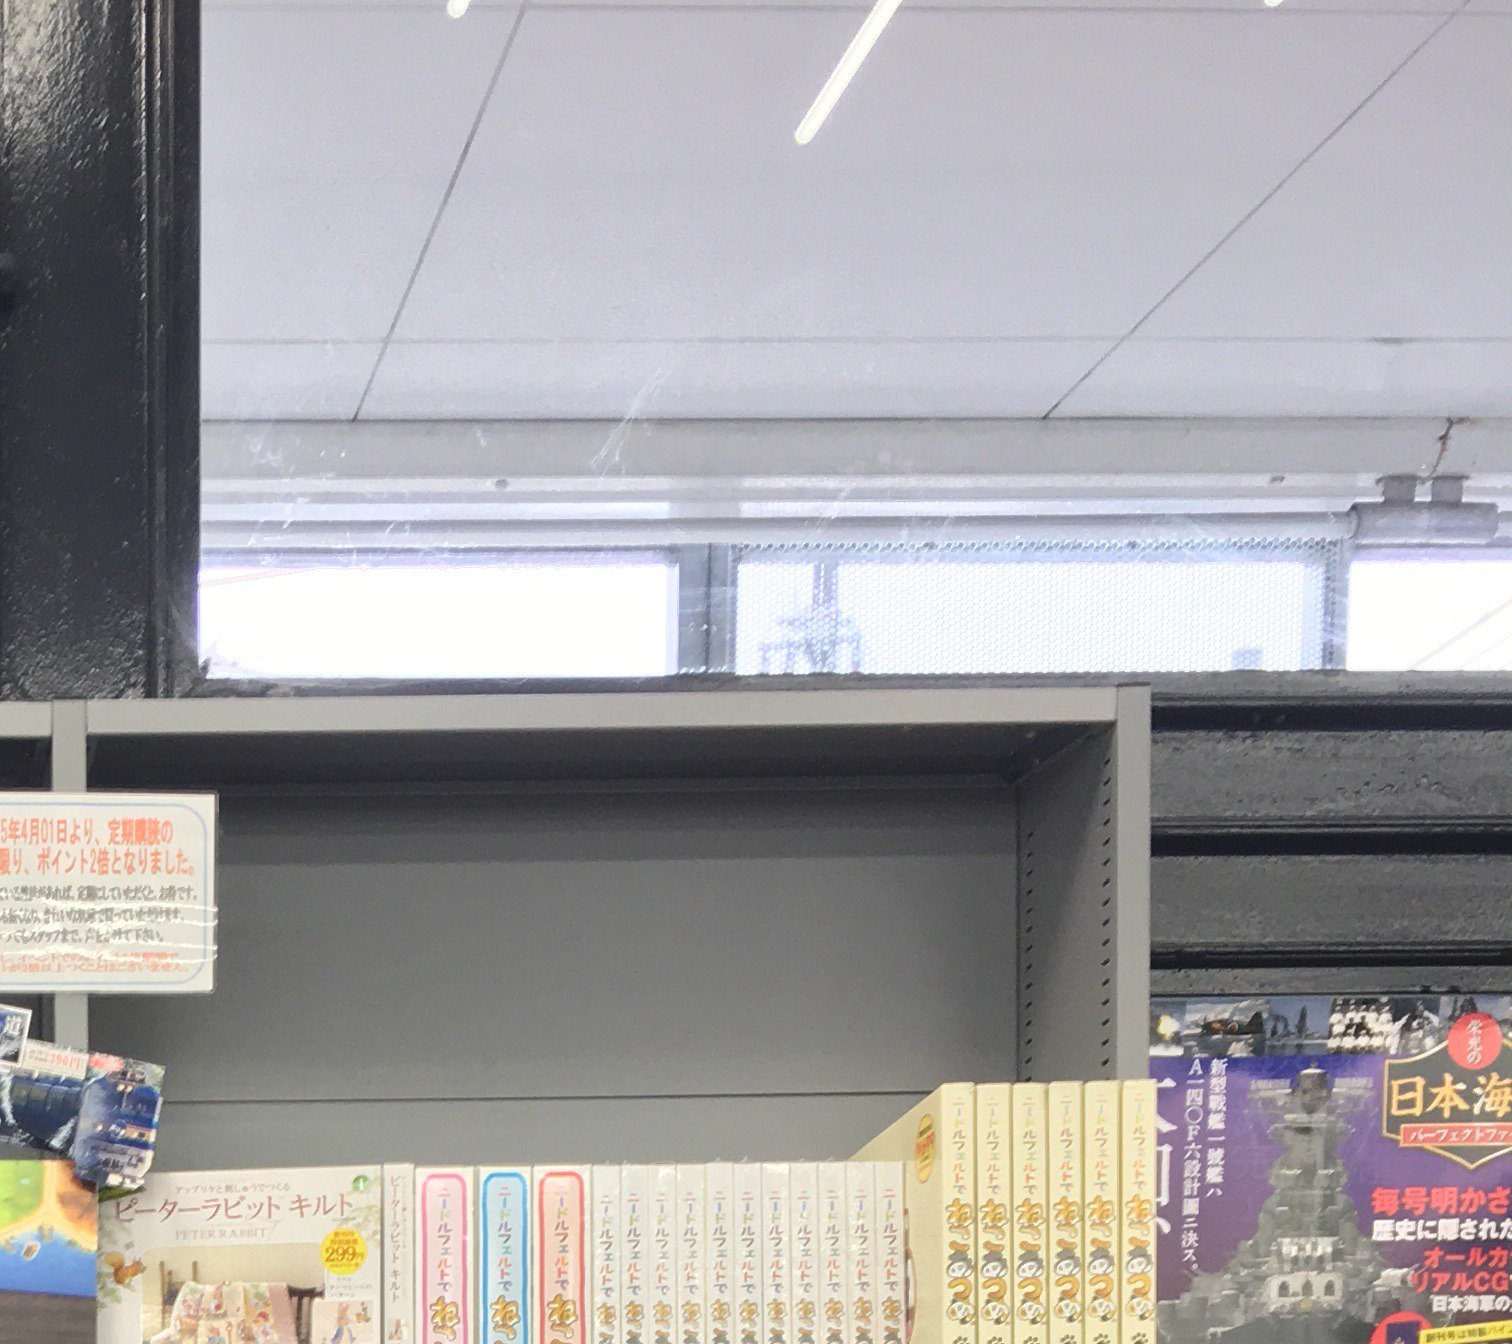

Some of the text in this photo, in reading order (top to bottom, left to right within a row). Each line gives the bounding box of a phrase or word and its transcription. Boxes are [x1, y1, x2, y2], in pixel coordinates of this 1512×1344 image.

[1390, 1071, 1512, 1119] 日本海
[1409, 1127, 1512, 1142] パーフェクトファ
[115, 1192, 354, 1224] ピーターラビット キルト
[1370, 1185, 1511, 1216] 毎号明かさ
[437, 1187, 453, 1293] ニードルフェルトで
[497, 1186, 513, 1293] ニードルフェルトで
[554, 1185, 570, 1291] ニードルフェルトで
[1423, 1246, 1512, 1269] オールカ
